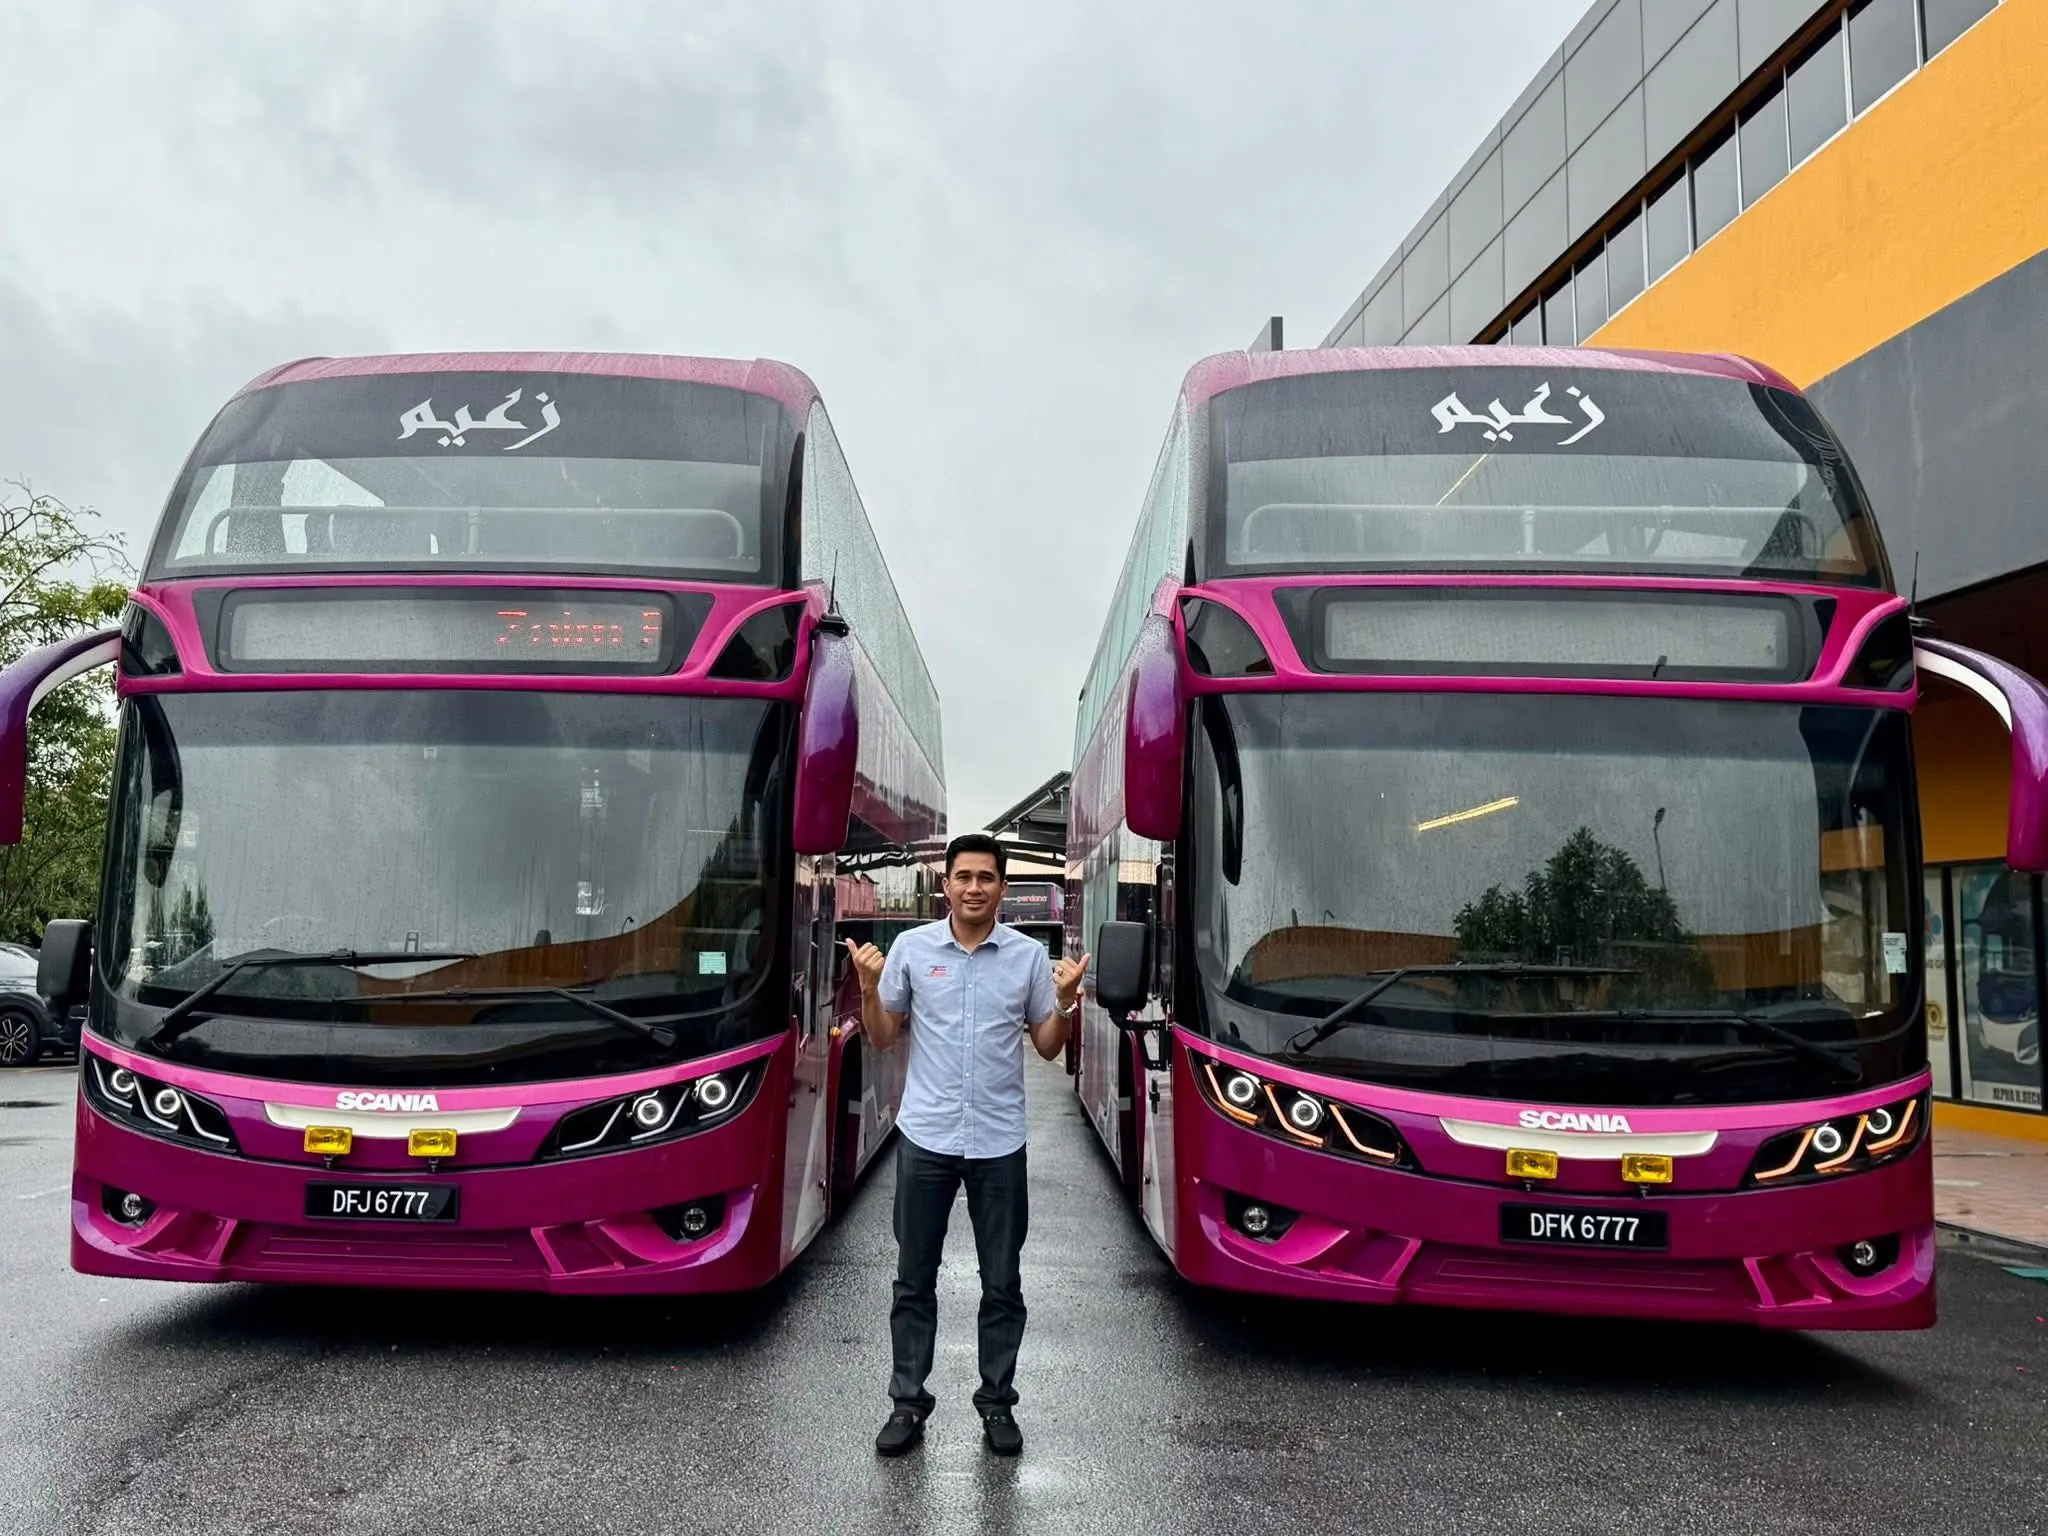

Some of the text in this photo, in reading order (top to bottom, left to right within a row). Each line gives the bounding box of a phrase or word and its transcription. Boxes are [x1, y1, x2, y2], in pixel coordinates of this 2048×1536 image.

[397, 388, 561, 450] زعيم
[1431, 381, 1605, 446] زعيم
[336, 1092, 439, 1112] SCANIA
[1519, 1110, 1632, 1133] SCANIA
[333, 1190, 429, 1215] DFJ 6777
[1530, 1212, 1639, 1241] DFK 6777
